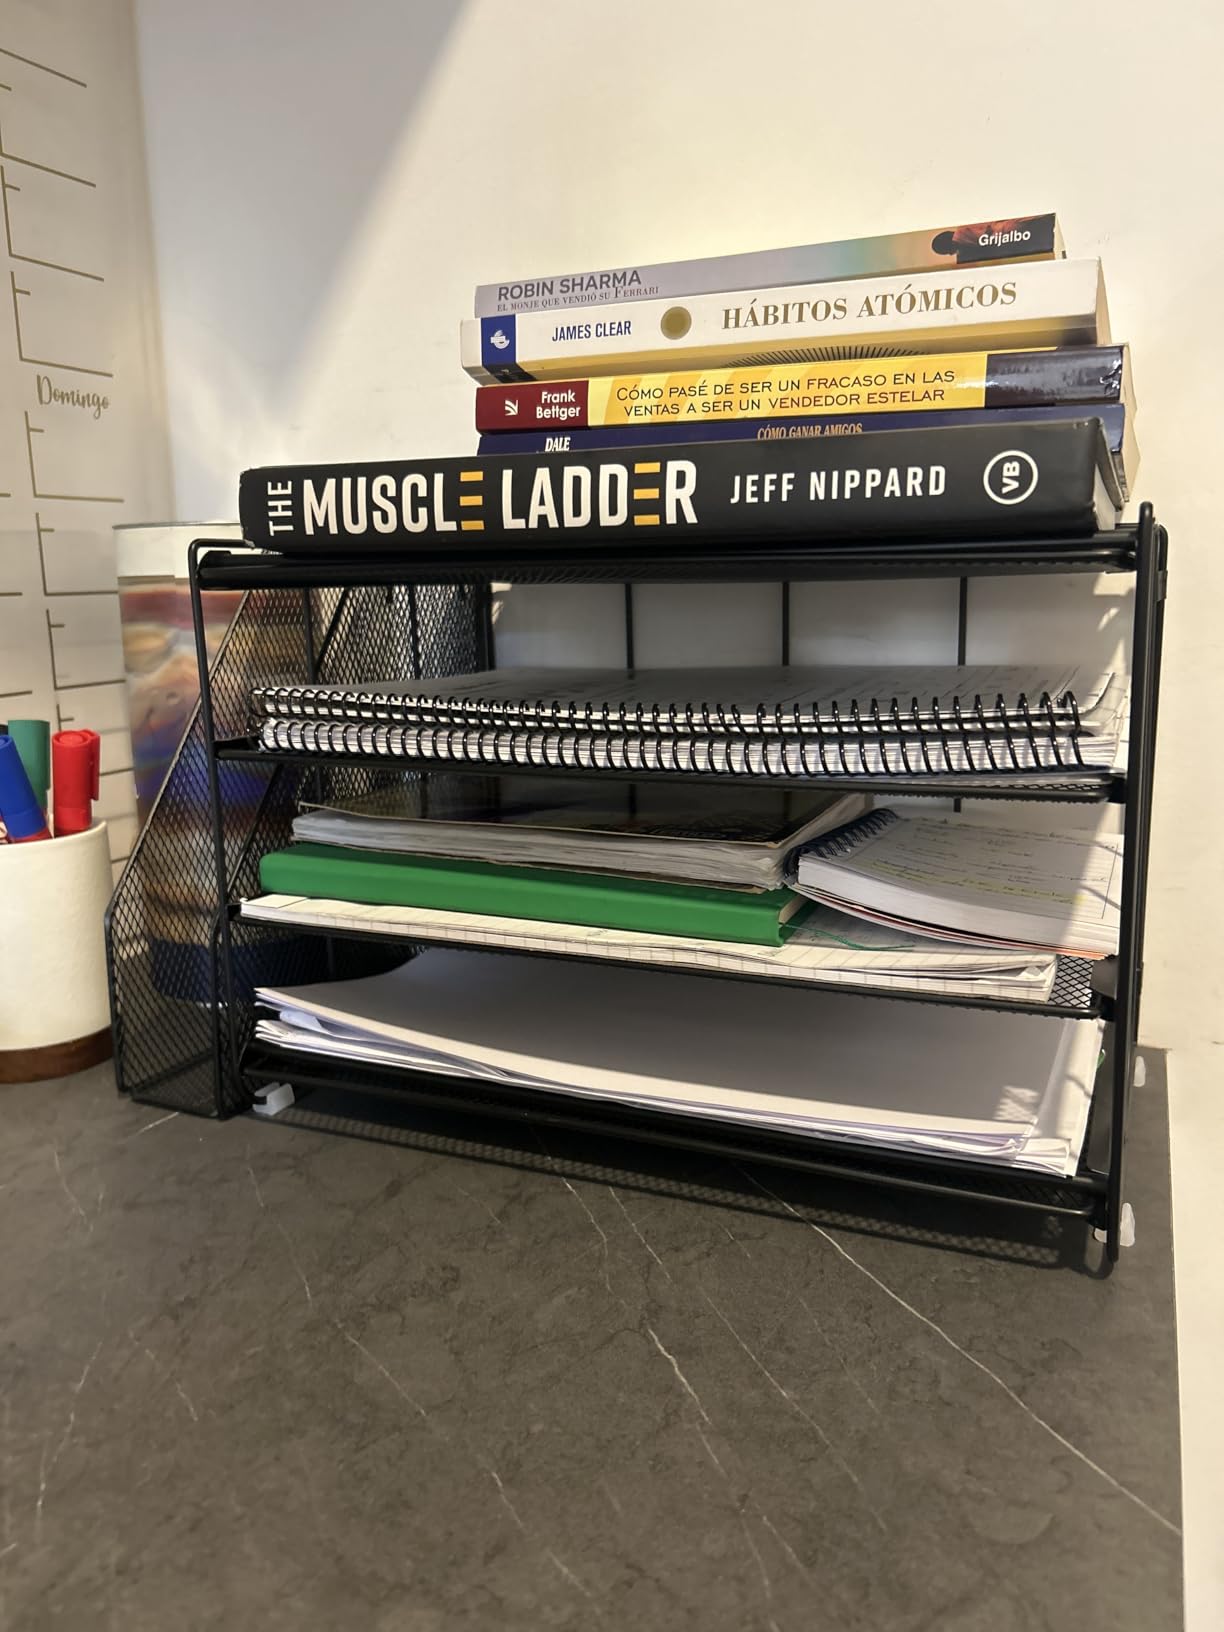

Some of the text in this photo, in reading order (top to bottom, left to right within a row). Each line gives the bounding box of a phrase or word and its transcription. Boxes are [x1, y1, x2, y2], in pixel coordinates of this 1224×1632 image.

[978, 229, 1031, 248] Grijalbo
[498, 270, 642, 301] ROBIN SHARMA
[497, 304, 508, 312] EL
[511, 301, 540, 311] MONJE
[541, 297, 560, 308] QUE
[562, 293, 597, 306] VENDIÓ
[600, 292, 611, 300] SU
[721, 281, 1018, 330] HÁBITOS ATÓMICOS
[552, 320, 632, 342] JAMES CLEAR
[36, 374, 110, 420] Domingo
[541, 390, 576, 404] Frank
[616, 370, 955, 401] CÓMO PASÉ DE SER UN FRACASO EN LAS
[535, 404, 581, 421] Bettger
[624, 389, 945, 417] VENTAS A SER UN VENDEDOR ESTELAR
[545, 436, 571, 452] DALE
[757, 422, 862, 440] CÓMO GANAR AMIGOS
[730, 465, 947, 504] JEFF NIPPARD
[1001, 461, 1021, 494] VB
[268, 460, 698, 536] THE MUSCLE LADDER
